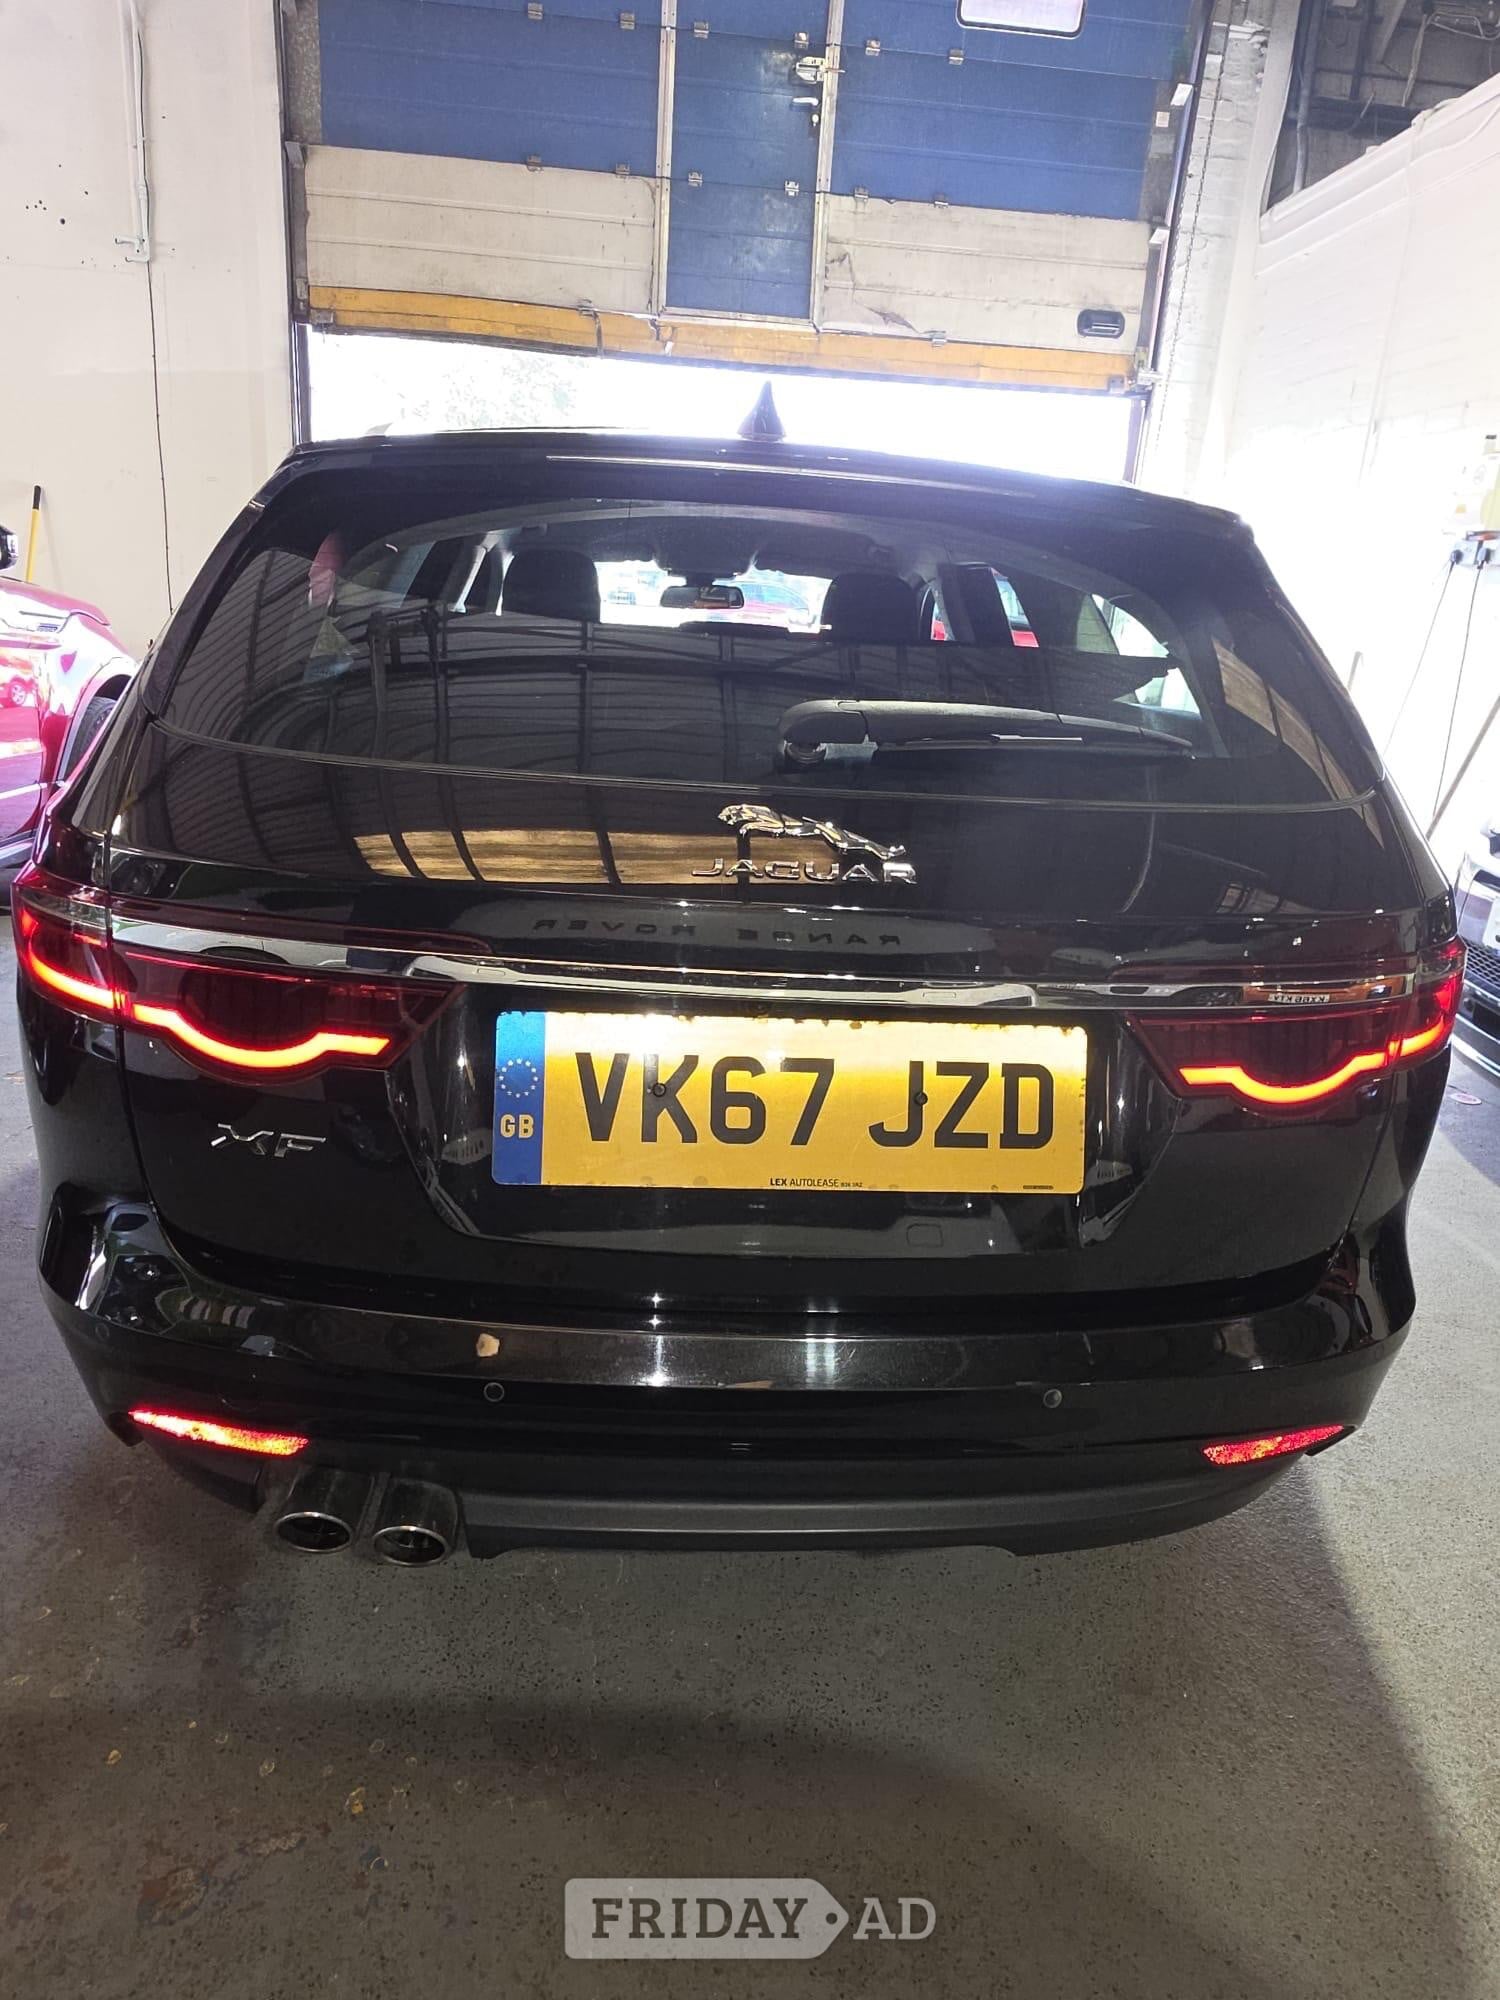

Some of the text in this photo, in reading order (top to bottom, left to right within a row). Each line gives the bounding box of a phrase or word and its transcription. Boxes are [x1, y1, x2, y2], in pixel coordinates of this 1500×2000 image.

[692, 858, 917, 885] JAGUAR
[574, 1051, 1055, 1150] VK67 JZD
[500, 1114, 534, 1139] GB
[210, 1122, 327, 1159] XF
[769, 1177, 788, 1187] LEX
[789, 1178, 840, 1188] AUTOLEASE
